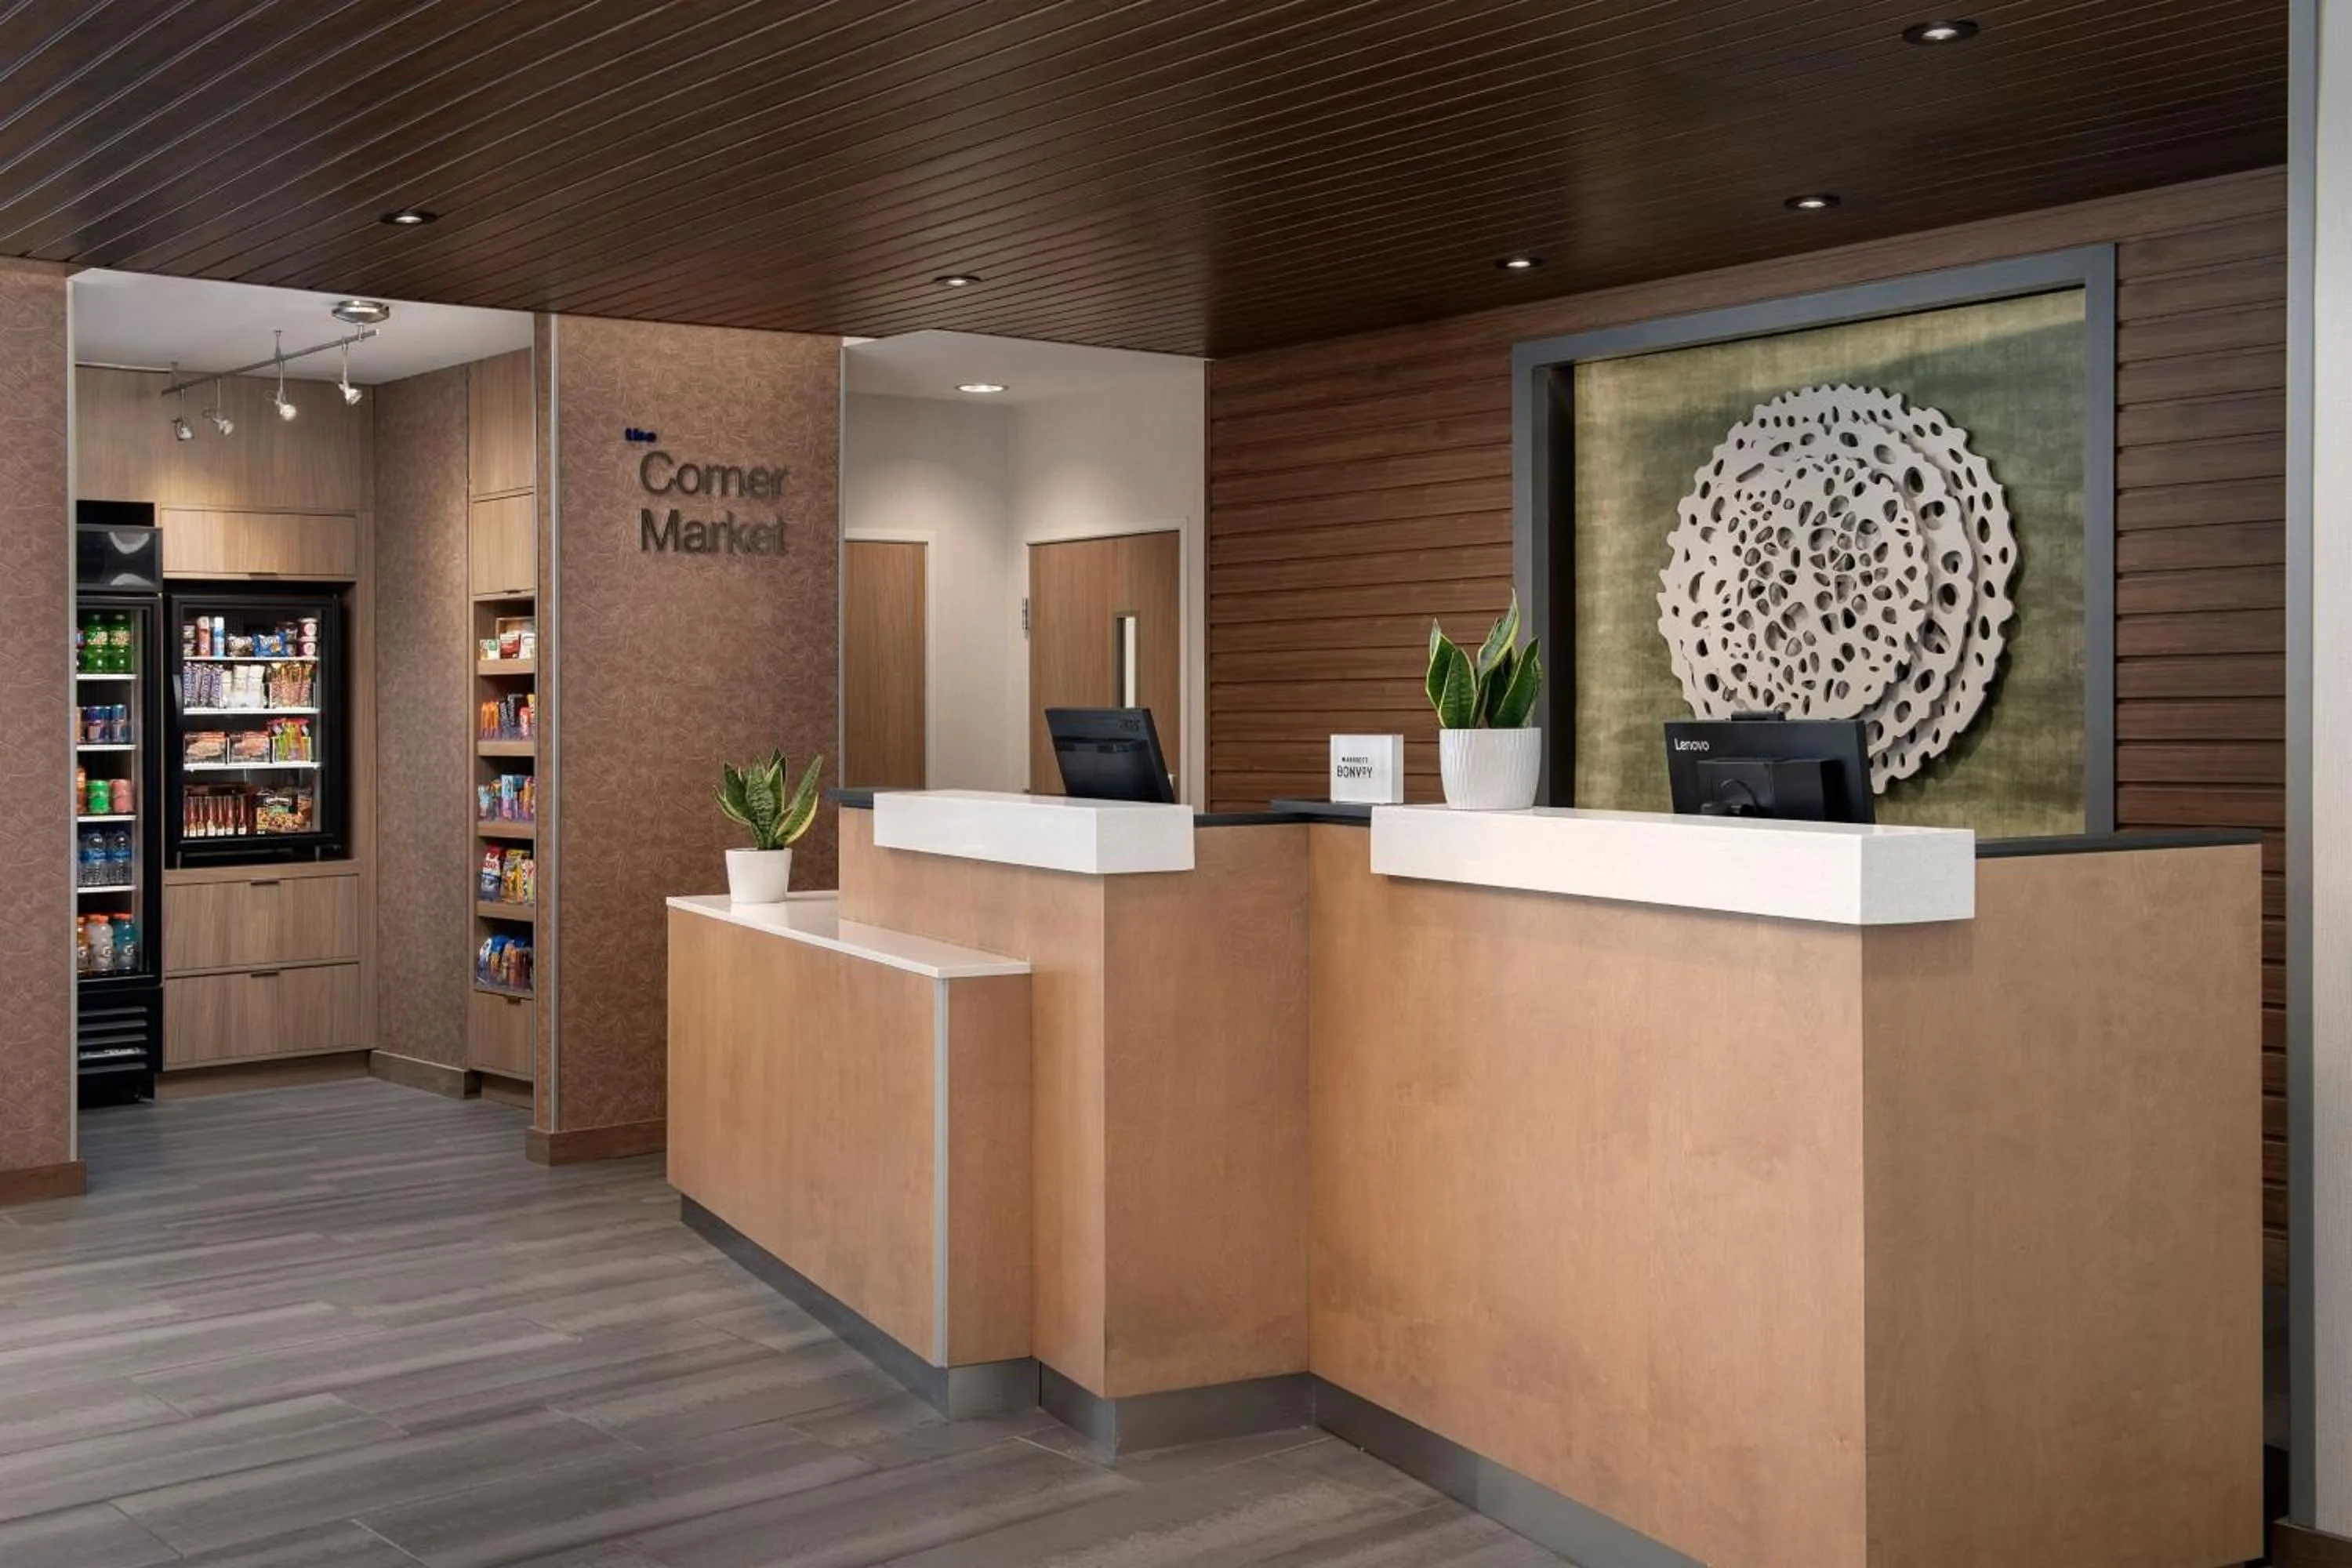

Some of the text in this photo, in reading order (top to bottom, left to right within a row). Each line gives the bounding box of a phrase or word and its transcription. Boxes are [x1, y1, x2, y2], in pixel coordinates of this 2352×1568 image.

[639, 450, 788, 499] Corner
[639, 507, 786, 556] Market
[1674, 737, 1710, 751] Lenovo
